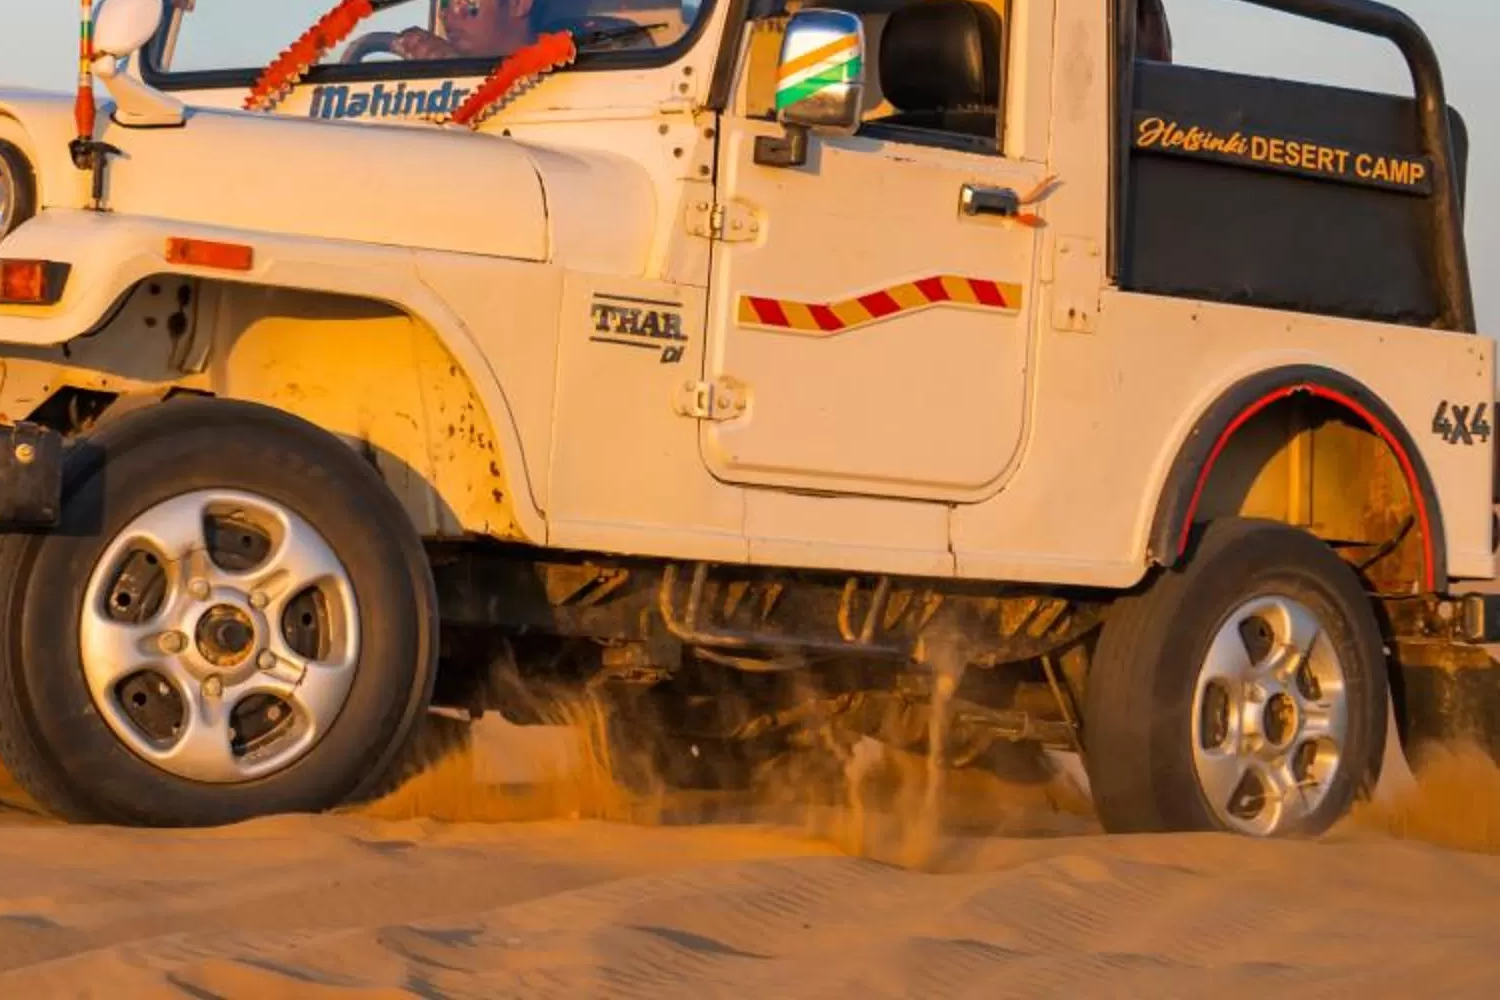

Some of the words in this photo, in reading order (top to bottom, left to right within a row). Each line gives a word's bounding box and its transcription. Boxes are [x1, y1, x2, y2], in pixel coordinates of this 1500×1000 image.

[309, 80, 470, 118] Mahindr
[1137, 117, 1249, 155] Helsinki
[1251, 135, 1350, 174] DESERT
[1355, 153, 1426, 185] CAMP
[591, 303, 688, 341] THAR
